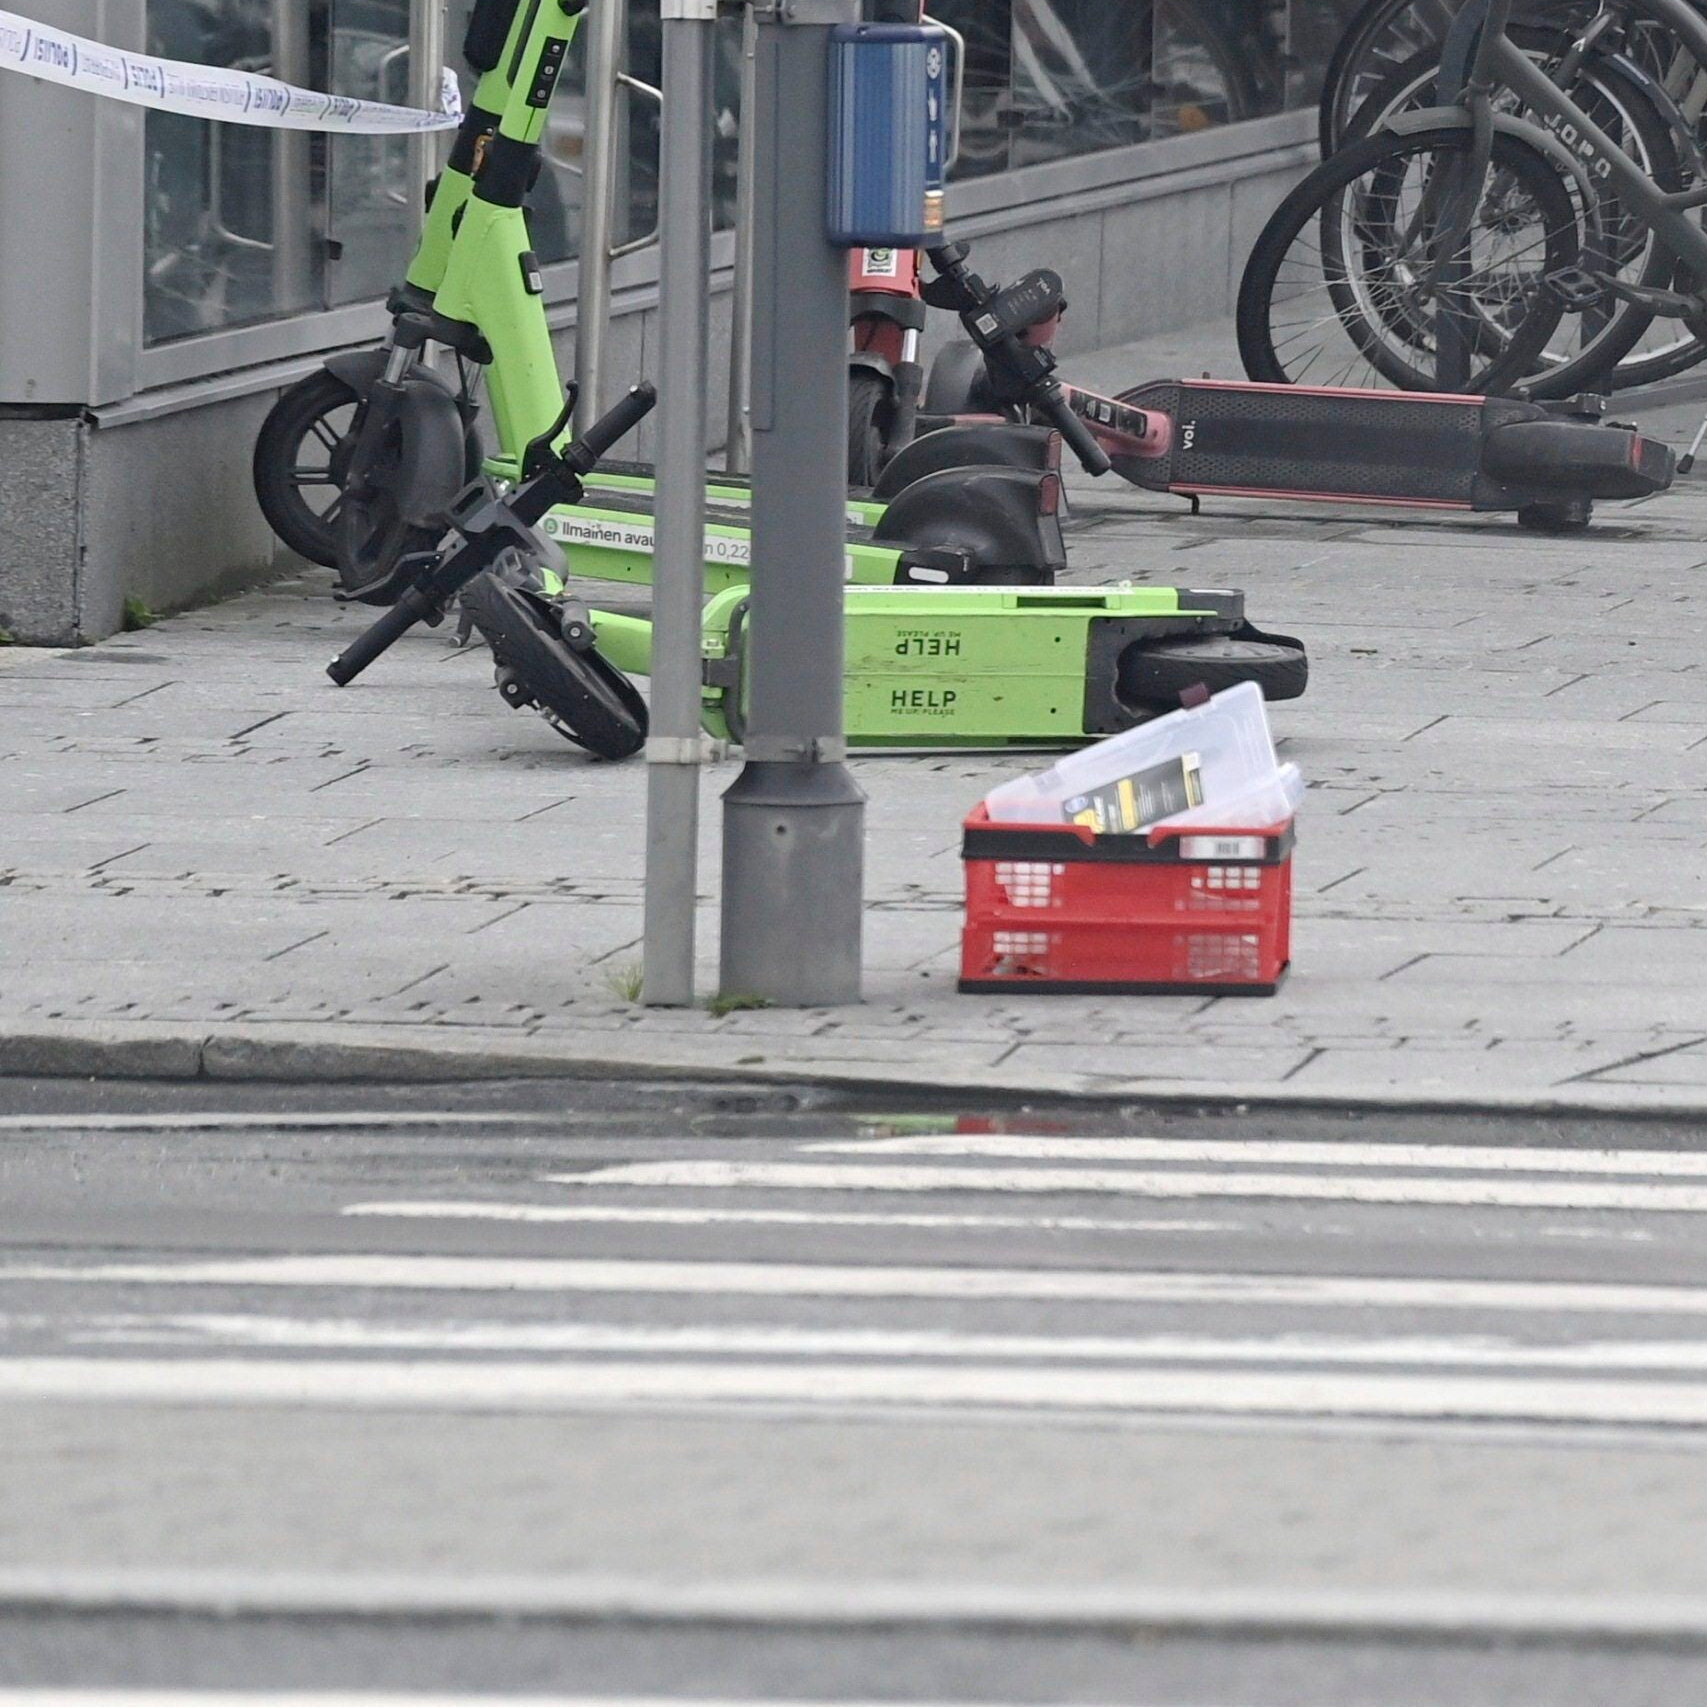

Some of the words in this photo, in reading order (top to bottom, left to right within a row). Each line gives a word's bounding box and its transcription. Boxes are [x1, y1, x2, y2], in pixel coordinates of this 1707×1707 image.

[1182, 419, 1197, 451] voi.
[561, 521, 622, 543] Ilmainen
[895, 638, 960, 655] HELP
[891, 690, 957, 707] HELP
